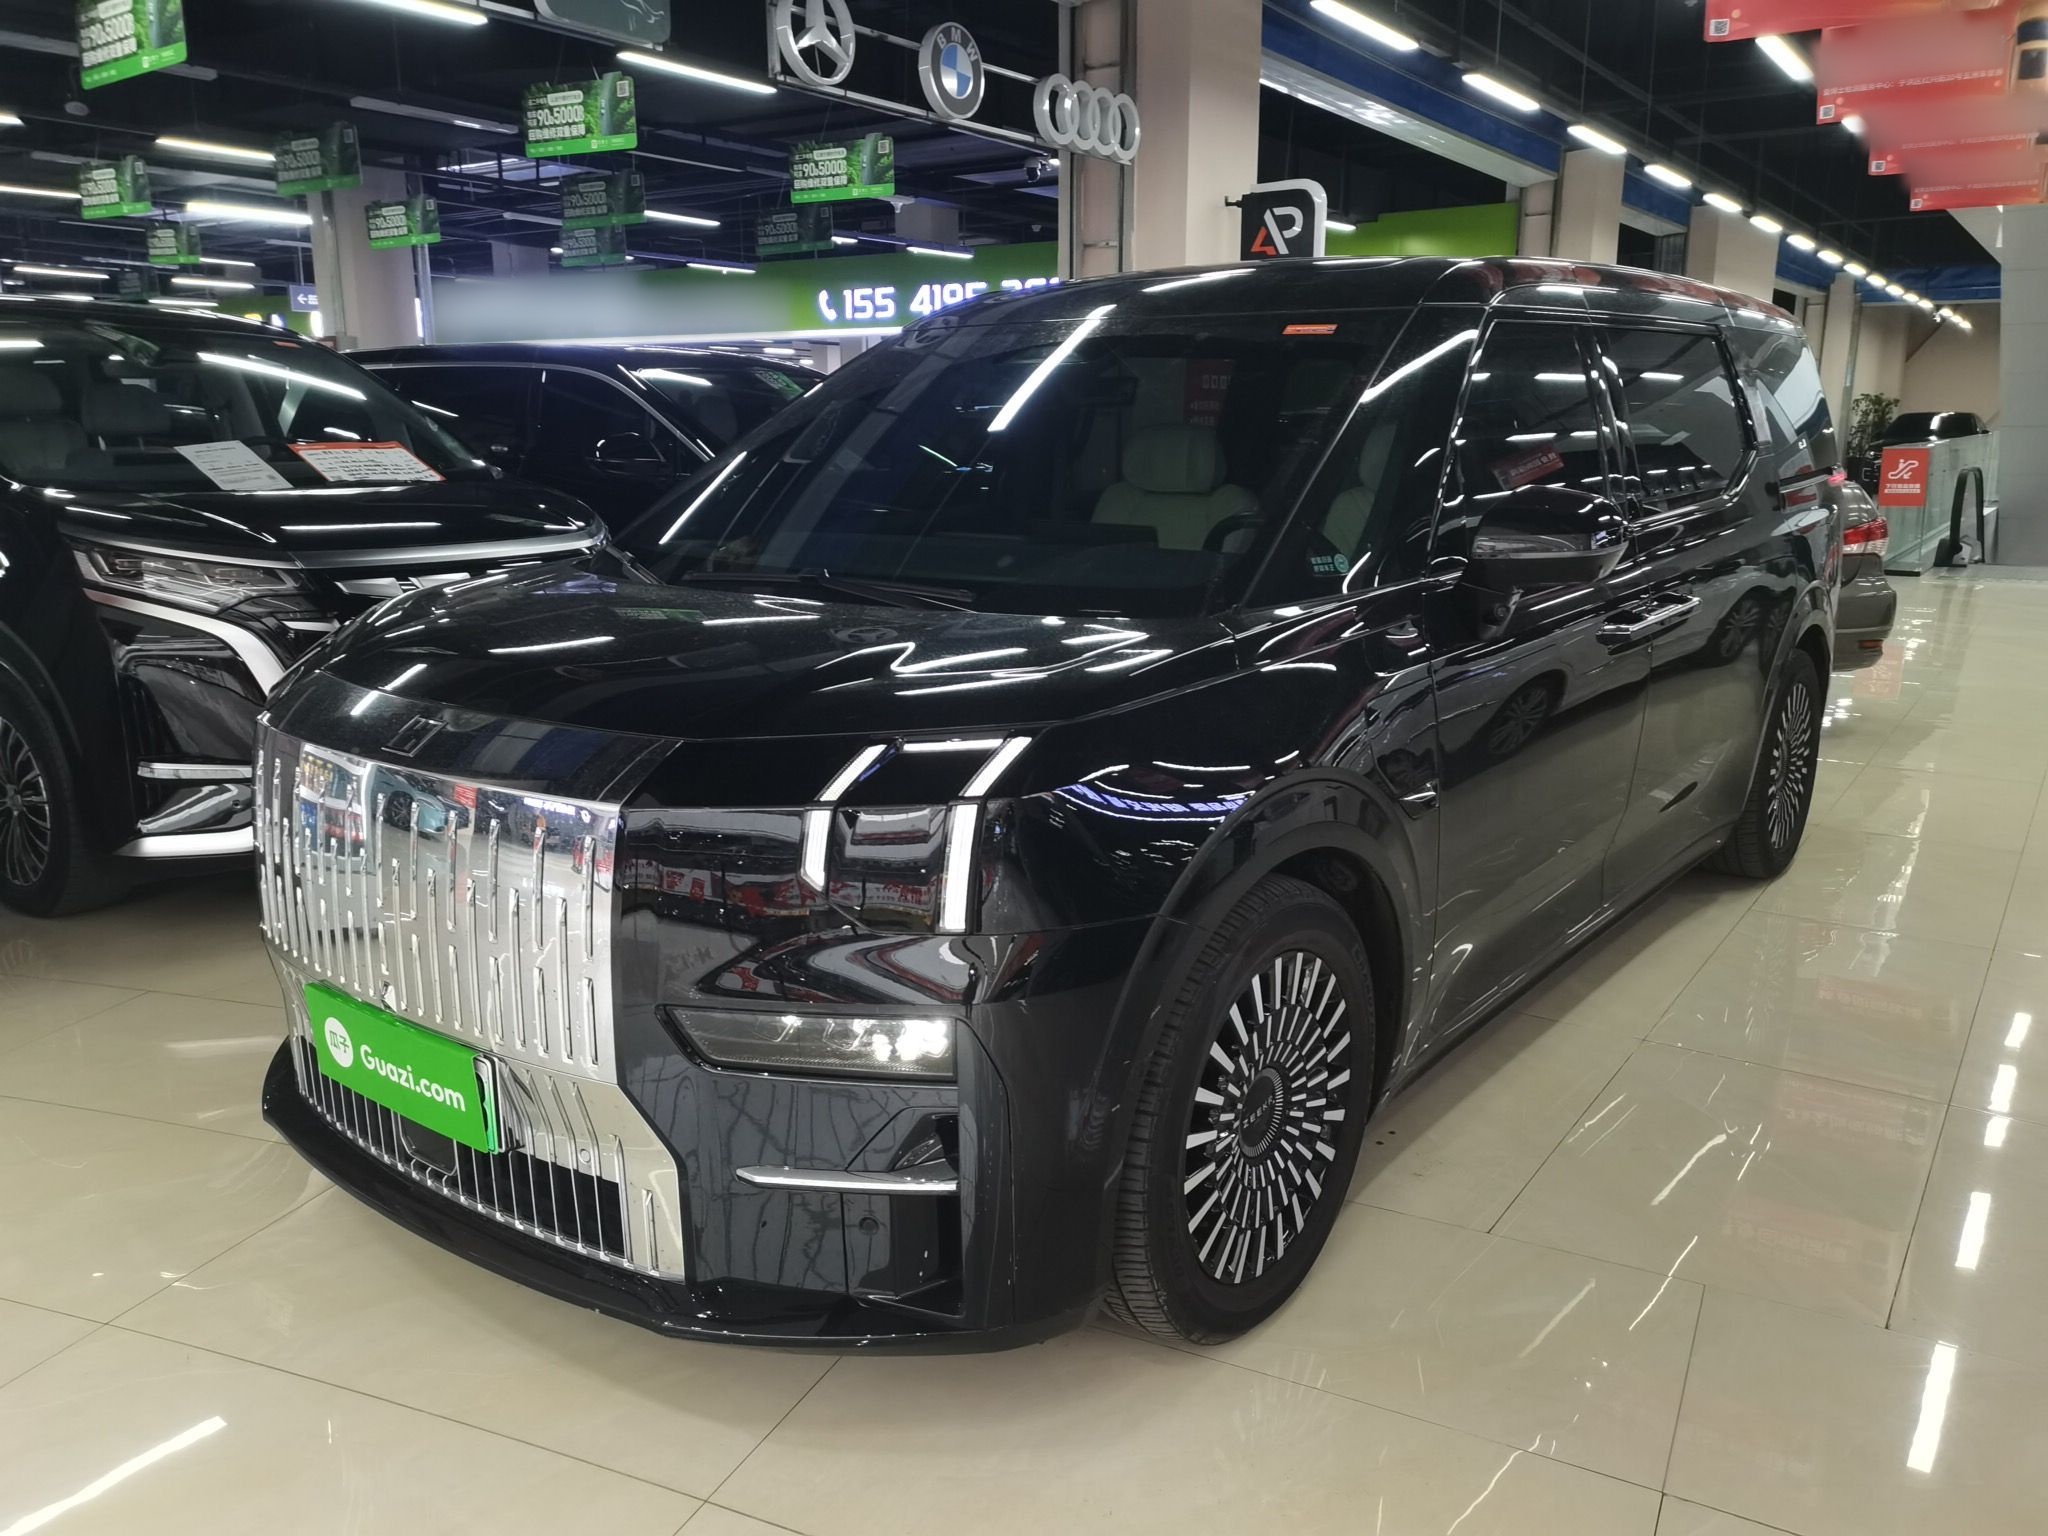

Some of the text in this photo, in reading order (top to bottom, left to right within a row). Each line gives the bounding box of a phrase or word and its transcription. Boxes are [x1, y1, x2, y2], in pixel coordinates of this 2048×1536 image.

[937, 27, 978, 62] BMW
[843, 286, 895, 320] 155
[329, 1030, 350, 1053] 瓜子
[360, 1044, 466, 1112] Guazi.com
